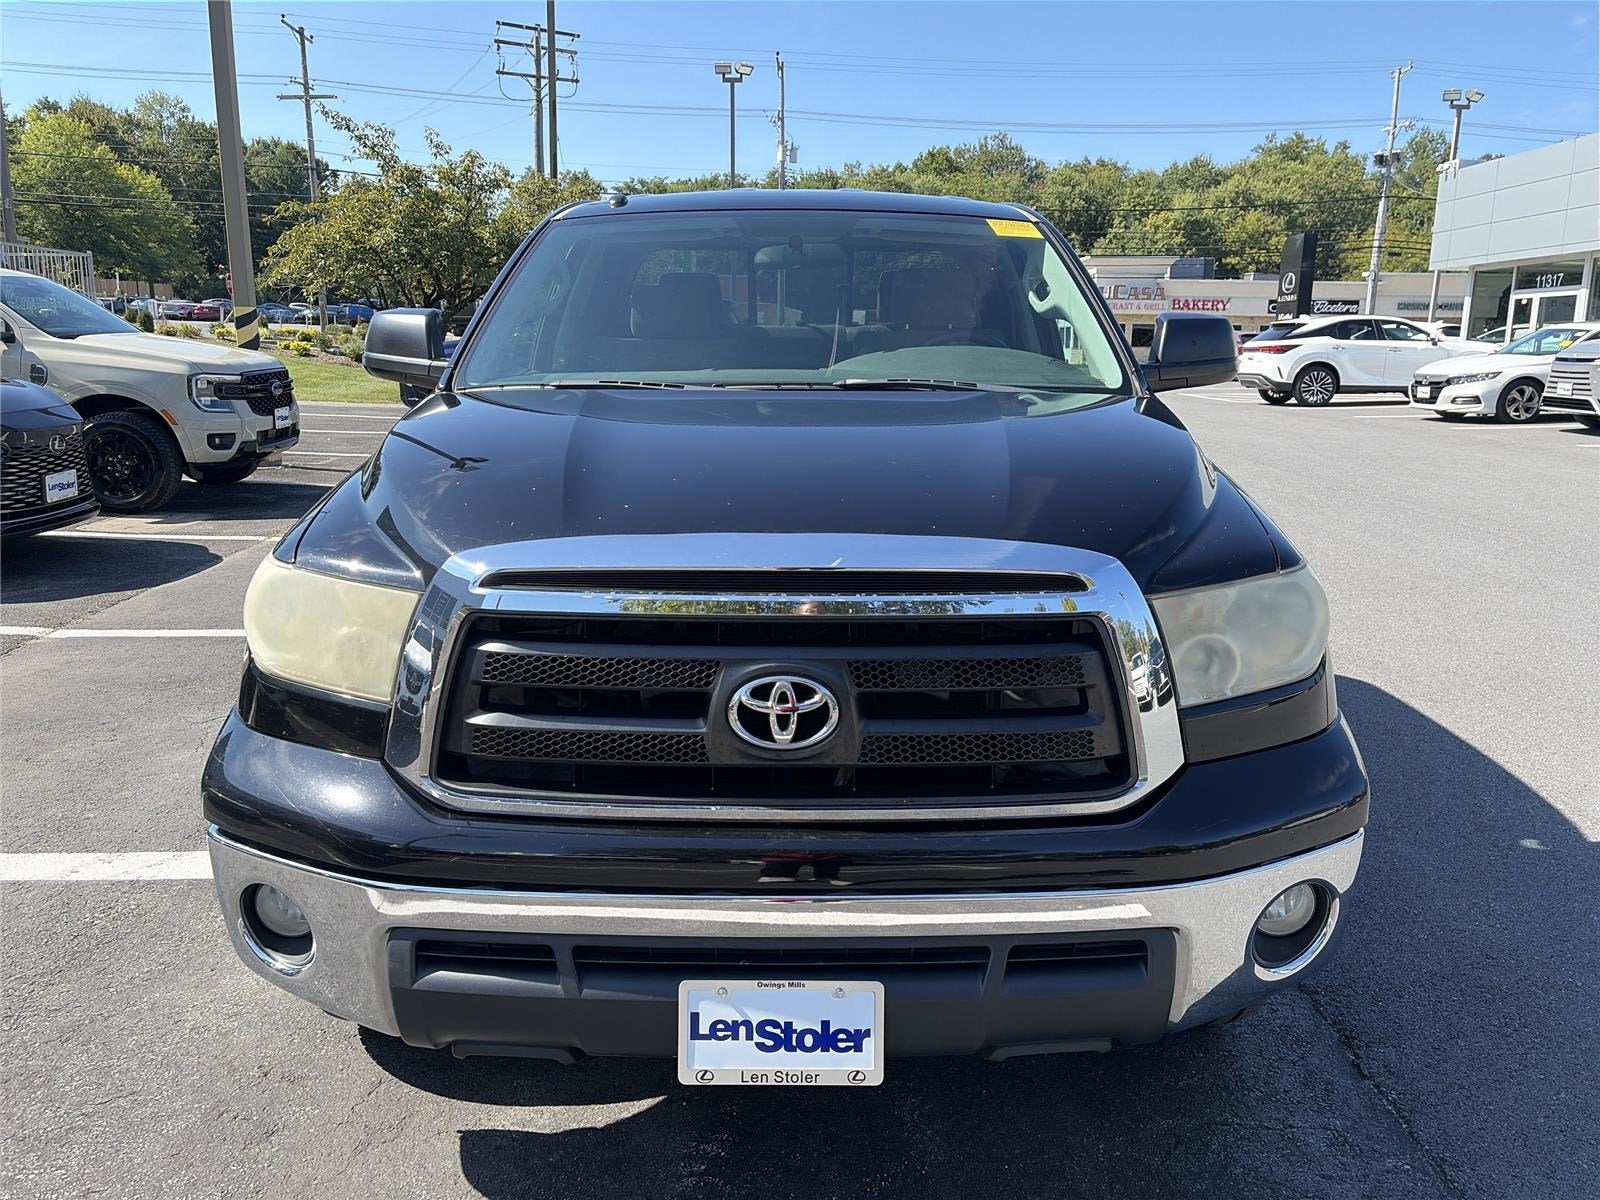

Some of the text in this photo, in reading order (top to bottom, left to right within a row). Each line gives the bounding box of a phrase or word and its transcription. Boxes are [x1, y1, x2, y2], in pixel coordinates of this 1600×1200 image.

[1536, 273, 1564, 288] 11317
[1171, 297, 1232, 311] BAKERY
[757, 981, 786, 989] Owings
[741, 1070, 820, 1084] Len Stoler
